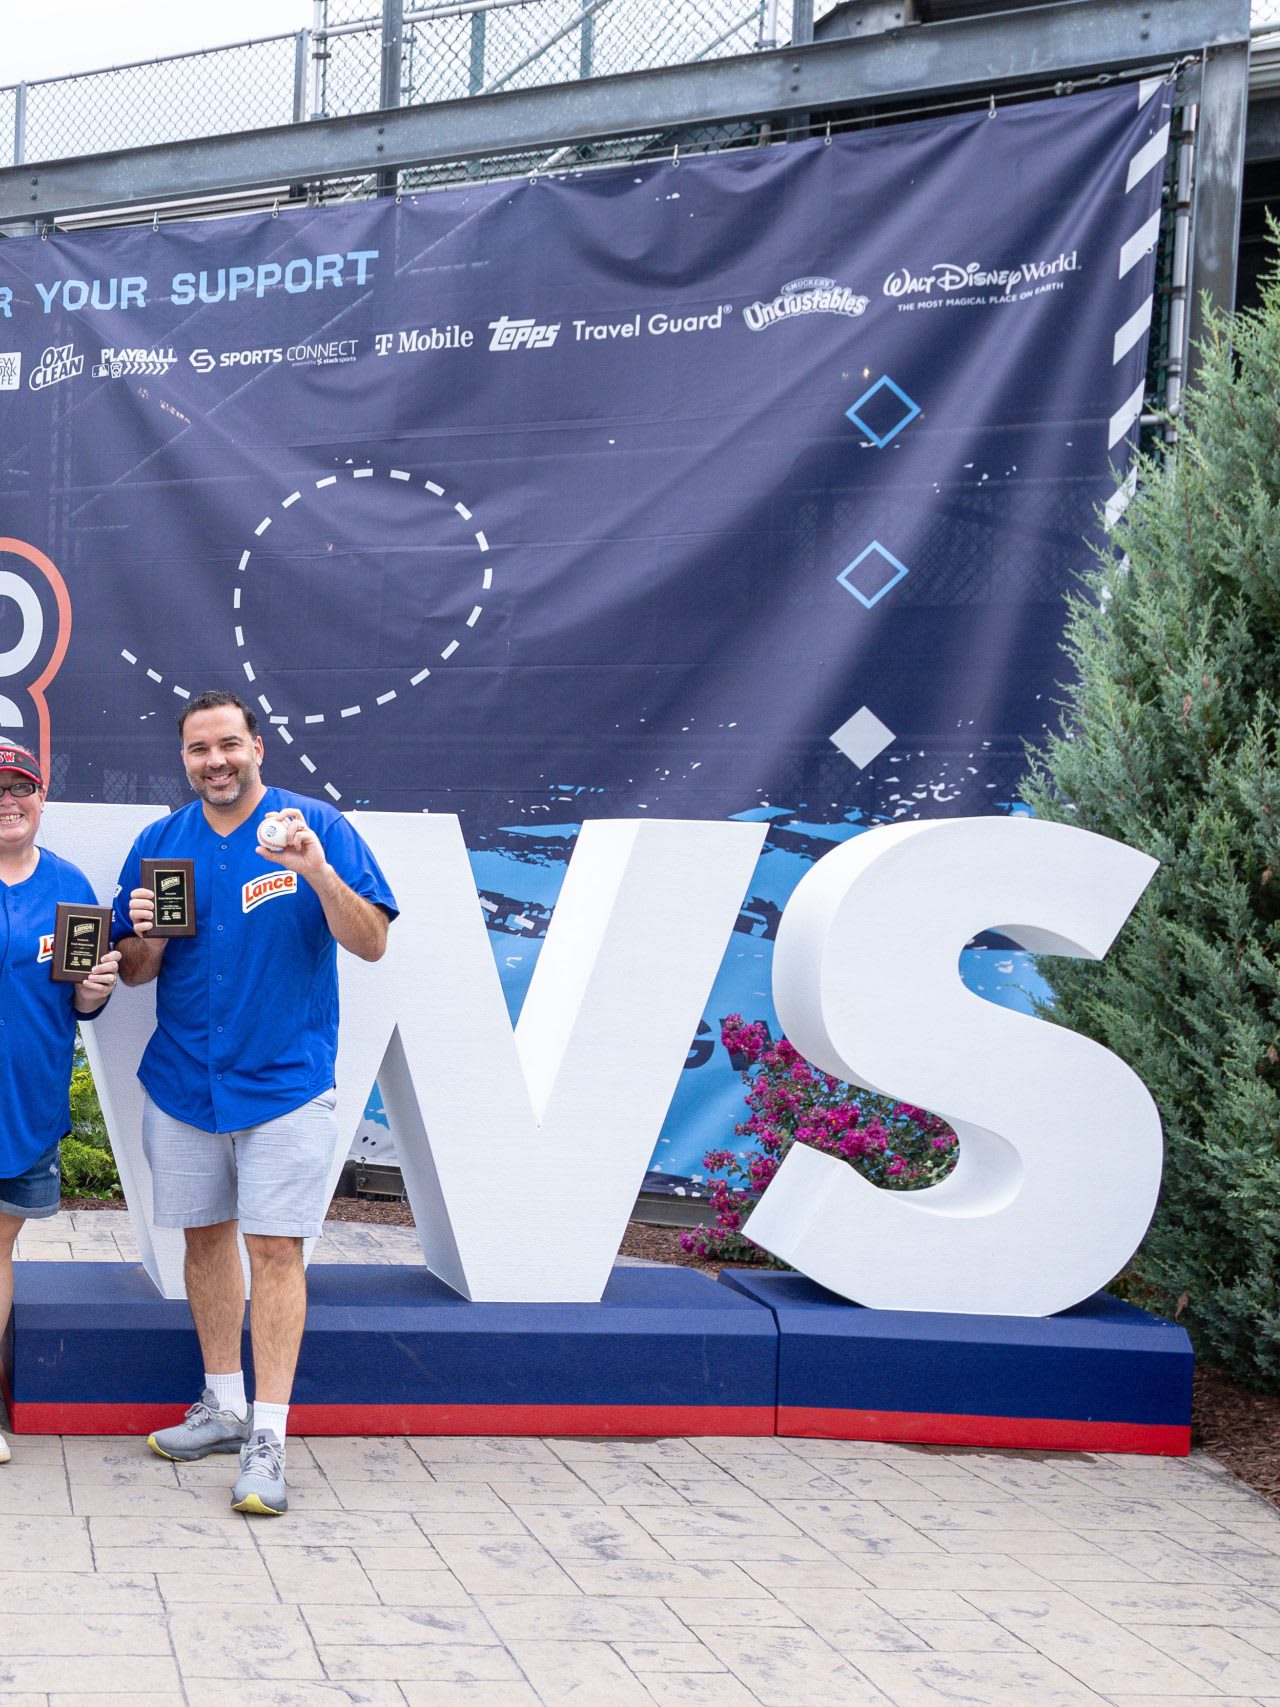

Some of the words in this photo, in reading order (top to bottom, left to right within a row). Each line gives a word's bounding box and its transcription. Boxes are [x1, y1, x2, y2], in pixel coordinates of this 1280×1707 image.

[1020, 251, 1077, 281] World
[35, 276, 148, 313] YOUR
[171, 250, 379, 305] SUPPORT
[745, 288, 867, 330] Uncrustables
[897, 303, 915, 312] THE
[918, 300, 943, 310] MOST
[946, 296, 987, 307] MAGICAL
[989, 294, 1017, 304] PLACE
[1020, 291, 1034, 300] ON
[1035, 282, 1064, 296] EARTH
[397, 325, 474, 353] Mobile
[573, 314, 640, 341] Travel
[42, 344, 73, 369] OXI
[101, 348, 177, 363] PLAYBALL
[220, 348, 282, 367] SPORTS
[287, 340, 358, 361] CONNECT
[31, 356, 83, 389] CLEAN
